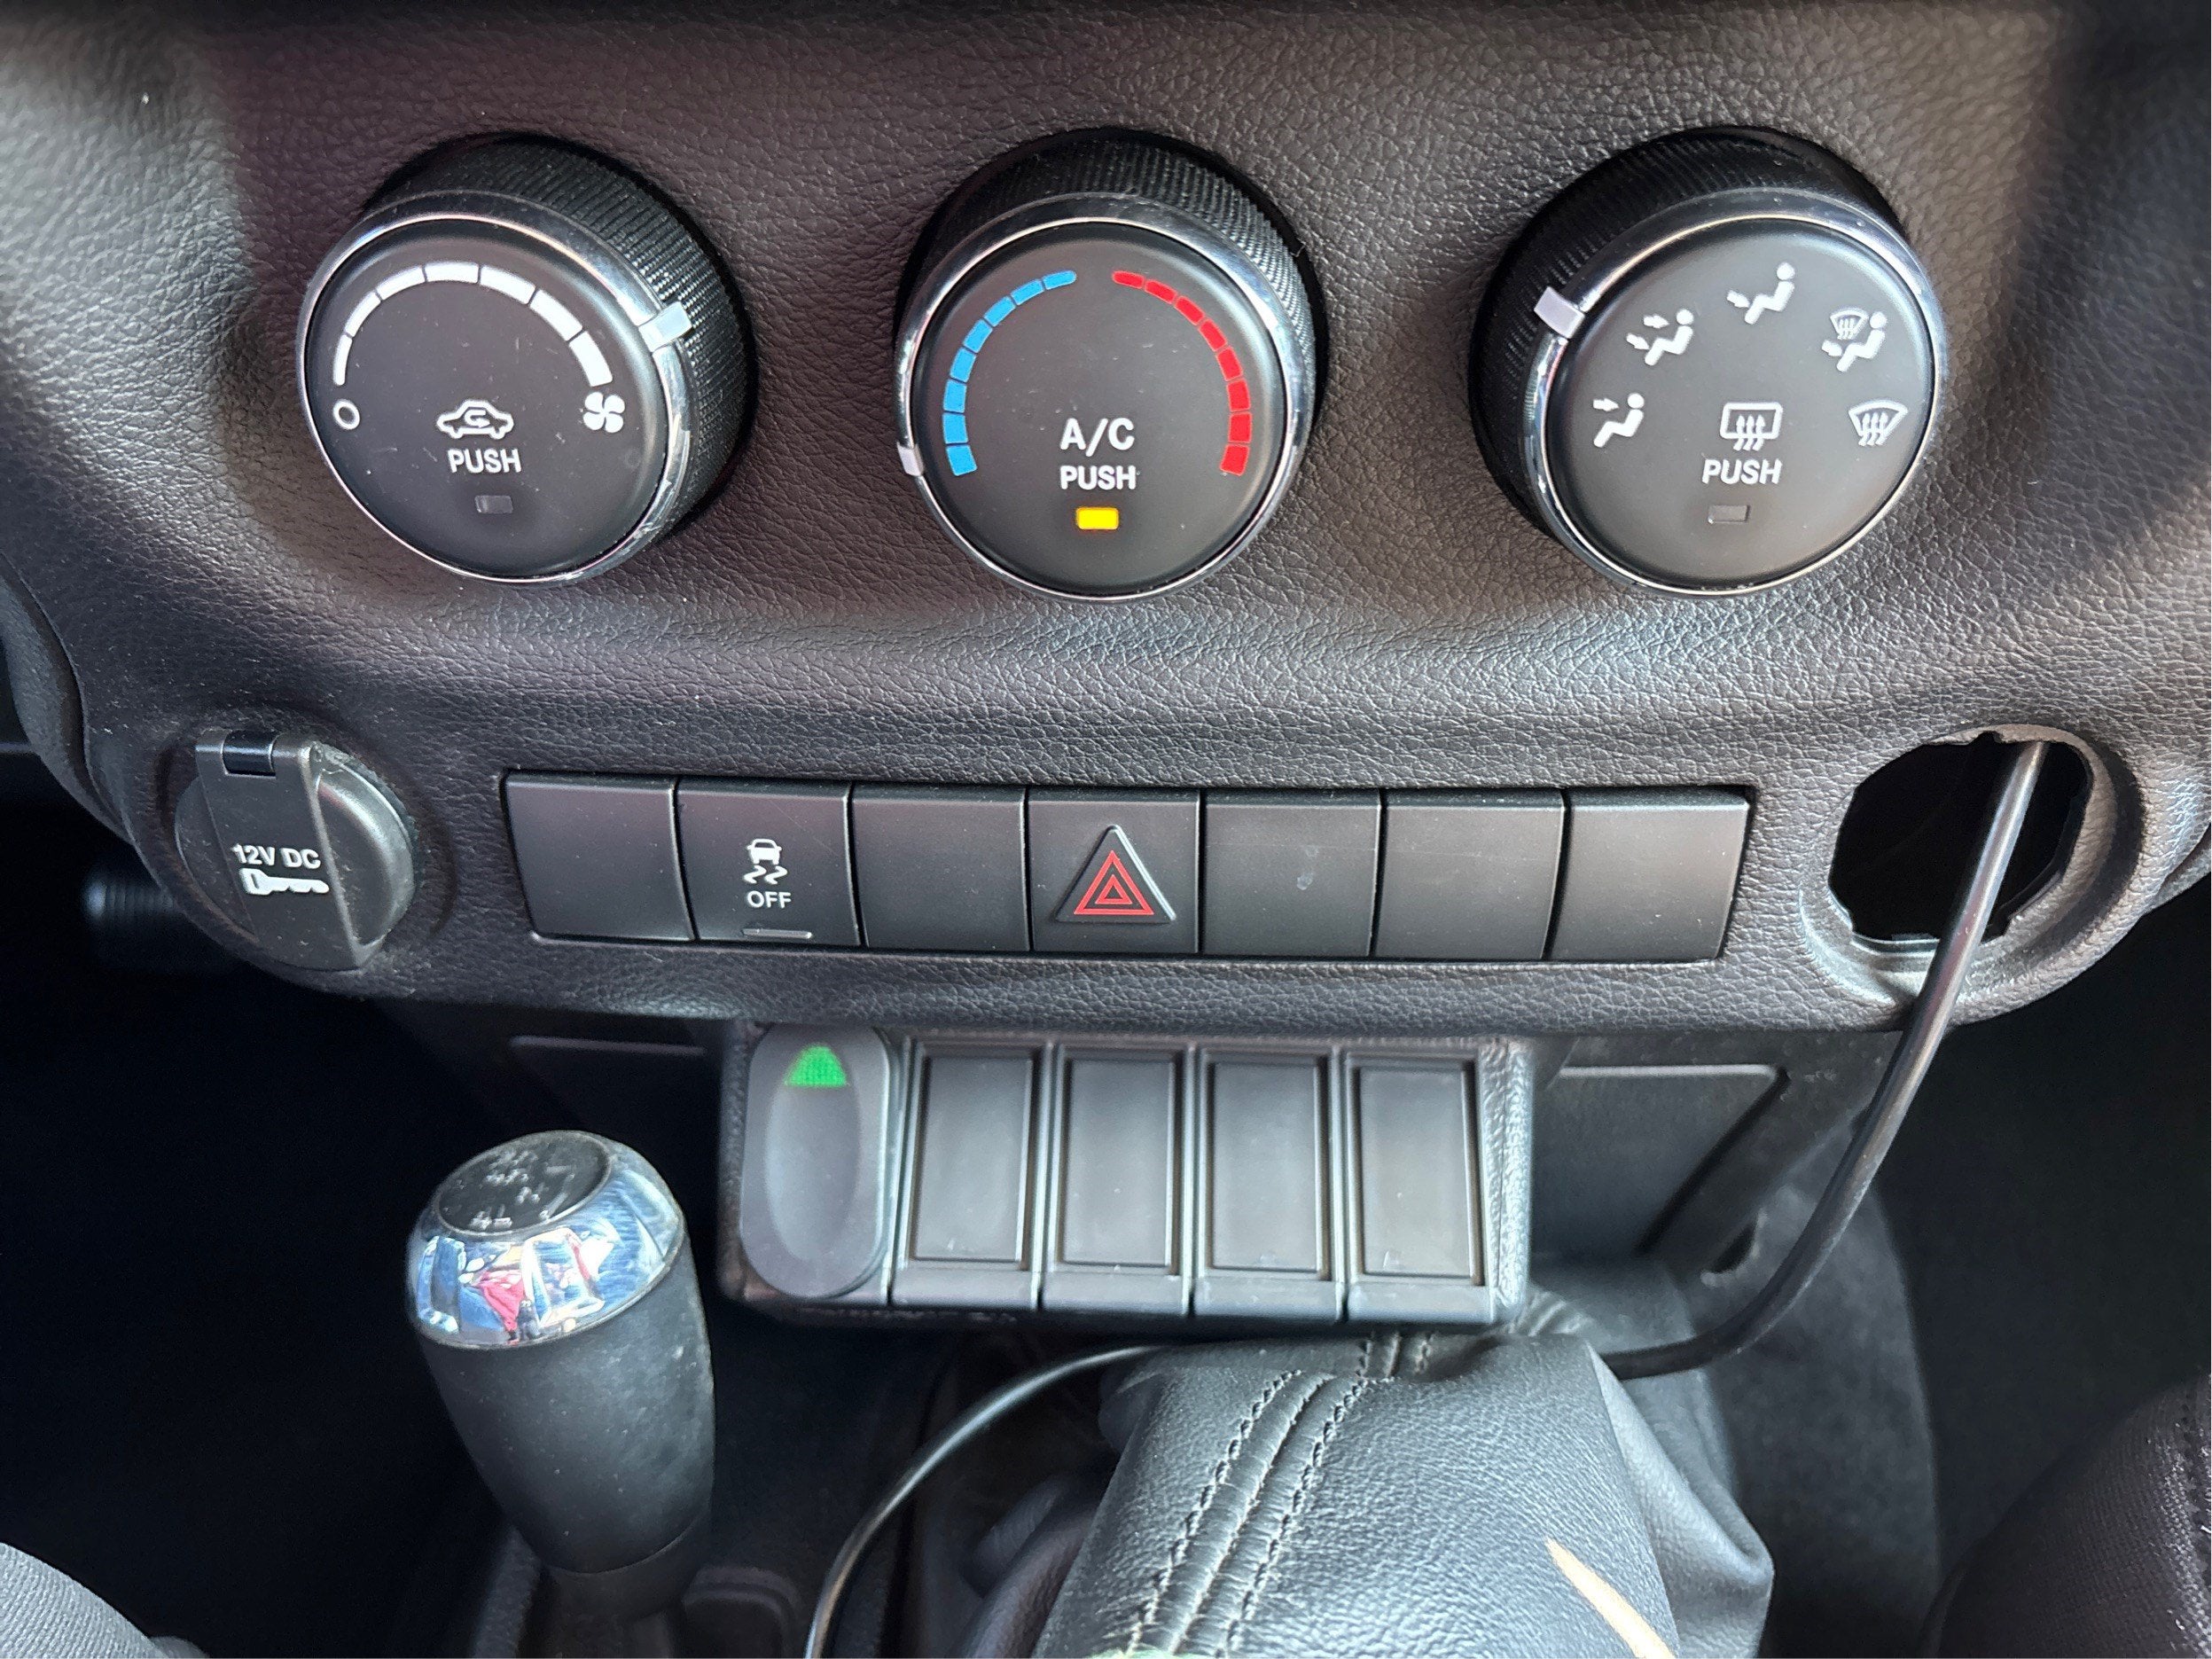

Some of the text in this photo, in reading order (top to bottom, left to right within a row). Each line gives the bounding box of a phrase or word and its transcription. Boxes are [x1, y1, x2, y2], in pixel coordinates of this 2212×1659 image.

[1059, 417, 1136, 458] A/C
[447, 448, 522, 474] PUSH
[1701, 458, 1784, 485] PUSH
[1059, 465, 1137, 490] PUSH
[231, 843, 322, 870] 12V DC
[746, 889, 793, 909] OFF
